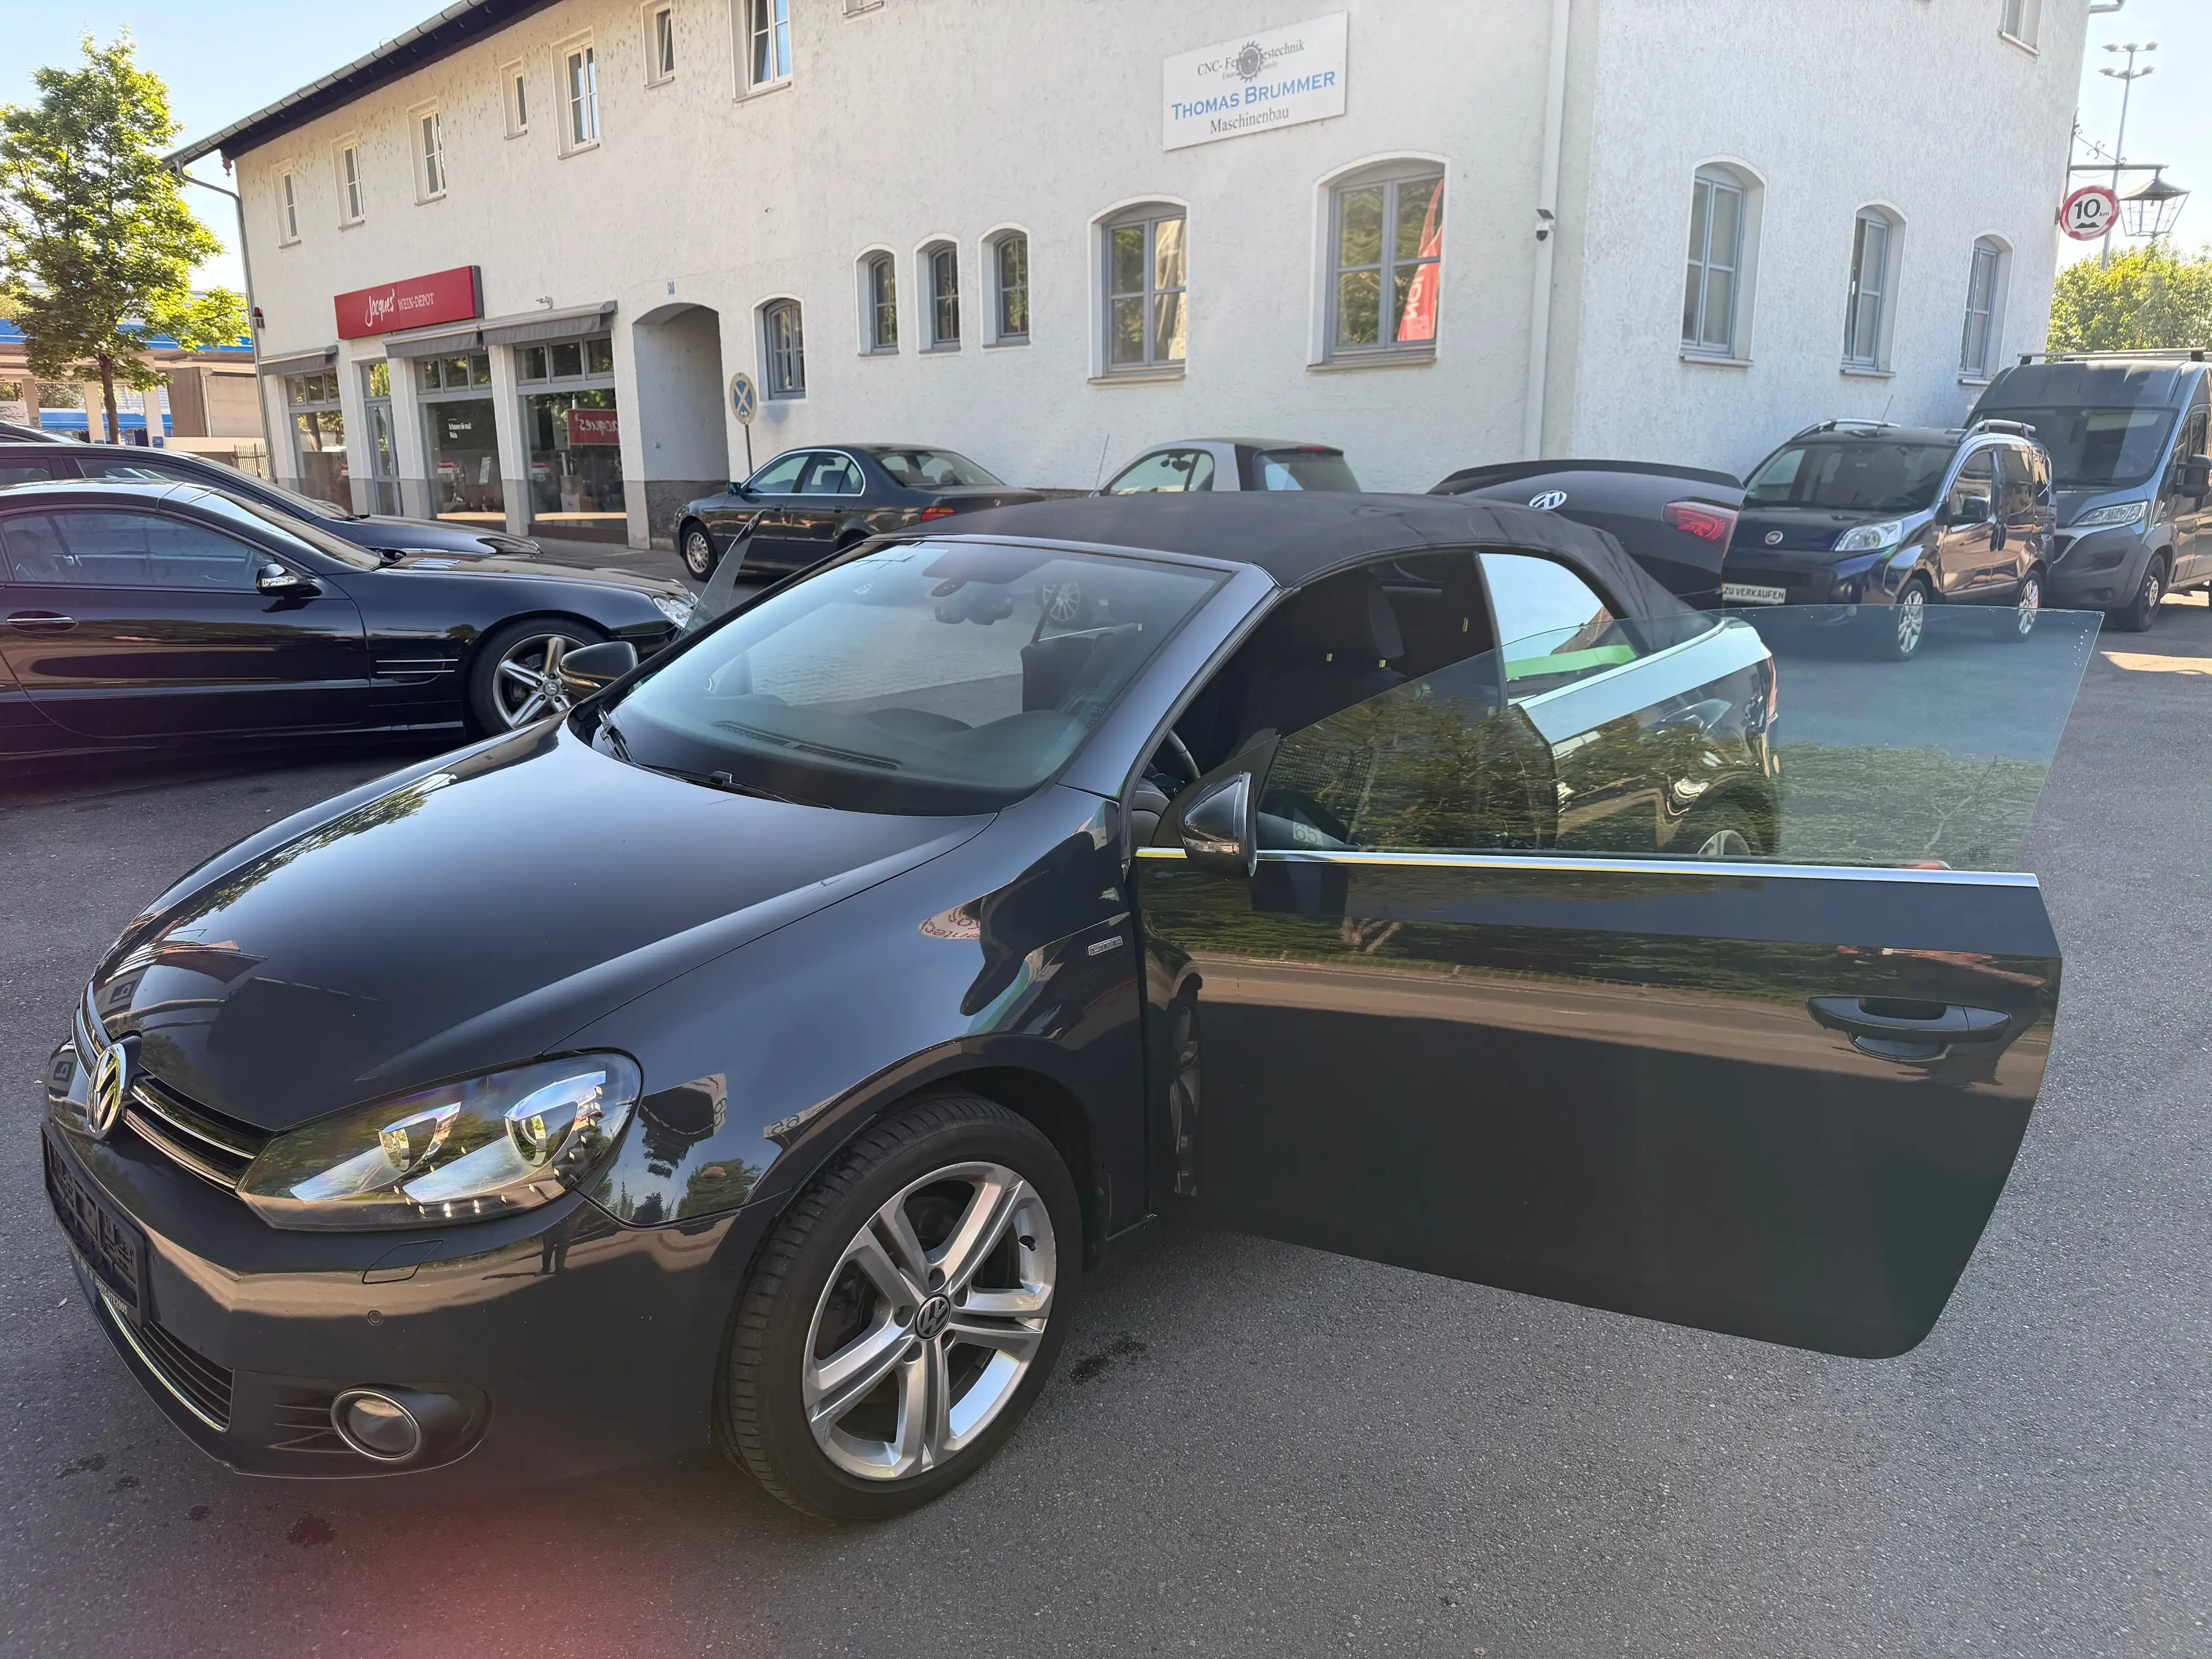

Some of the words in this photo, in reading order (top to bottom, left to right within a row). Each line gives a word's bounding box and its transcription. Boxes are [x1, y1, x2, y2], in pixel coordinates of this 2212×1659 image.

[1197, 59, 1222, 76] CNC-
[1171, 93, 1240, 120] THOMAS
[1244, 71, 1335, 105] BRUMMER
[1210, 107, 1289, 134] Maschinenbau
[2074, 198, 2100, 219] 10
[365, 288, 395, 327] Jacques'
[397, 293, 434, 310] WEIN-DEPOT
[1724, 586, 1734, 594] ZU
[1736, 588, 1785, 600] VERKAUFEN
[1091, 937, 1122, 952] LIFE
